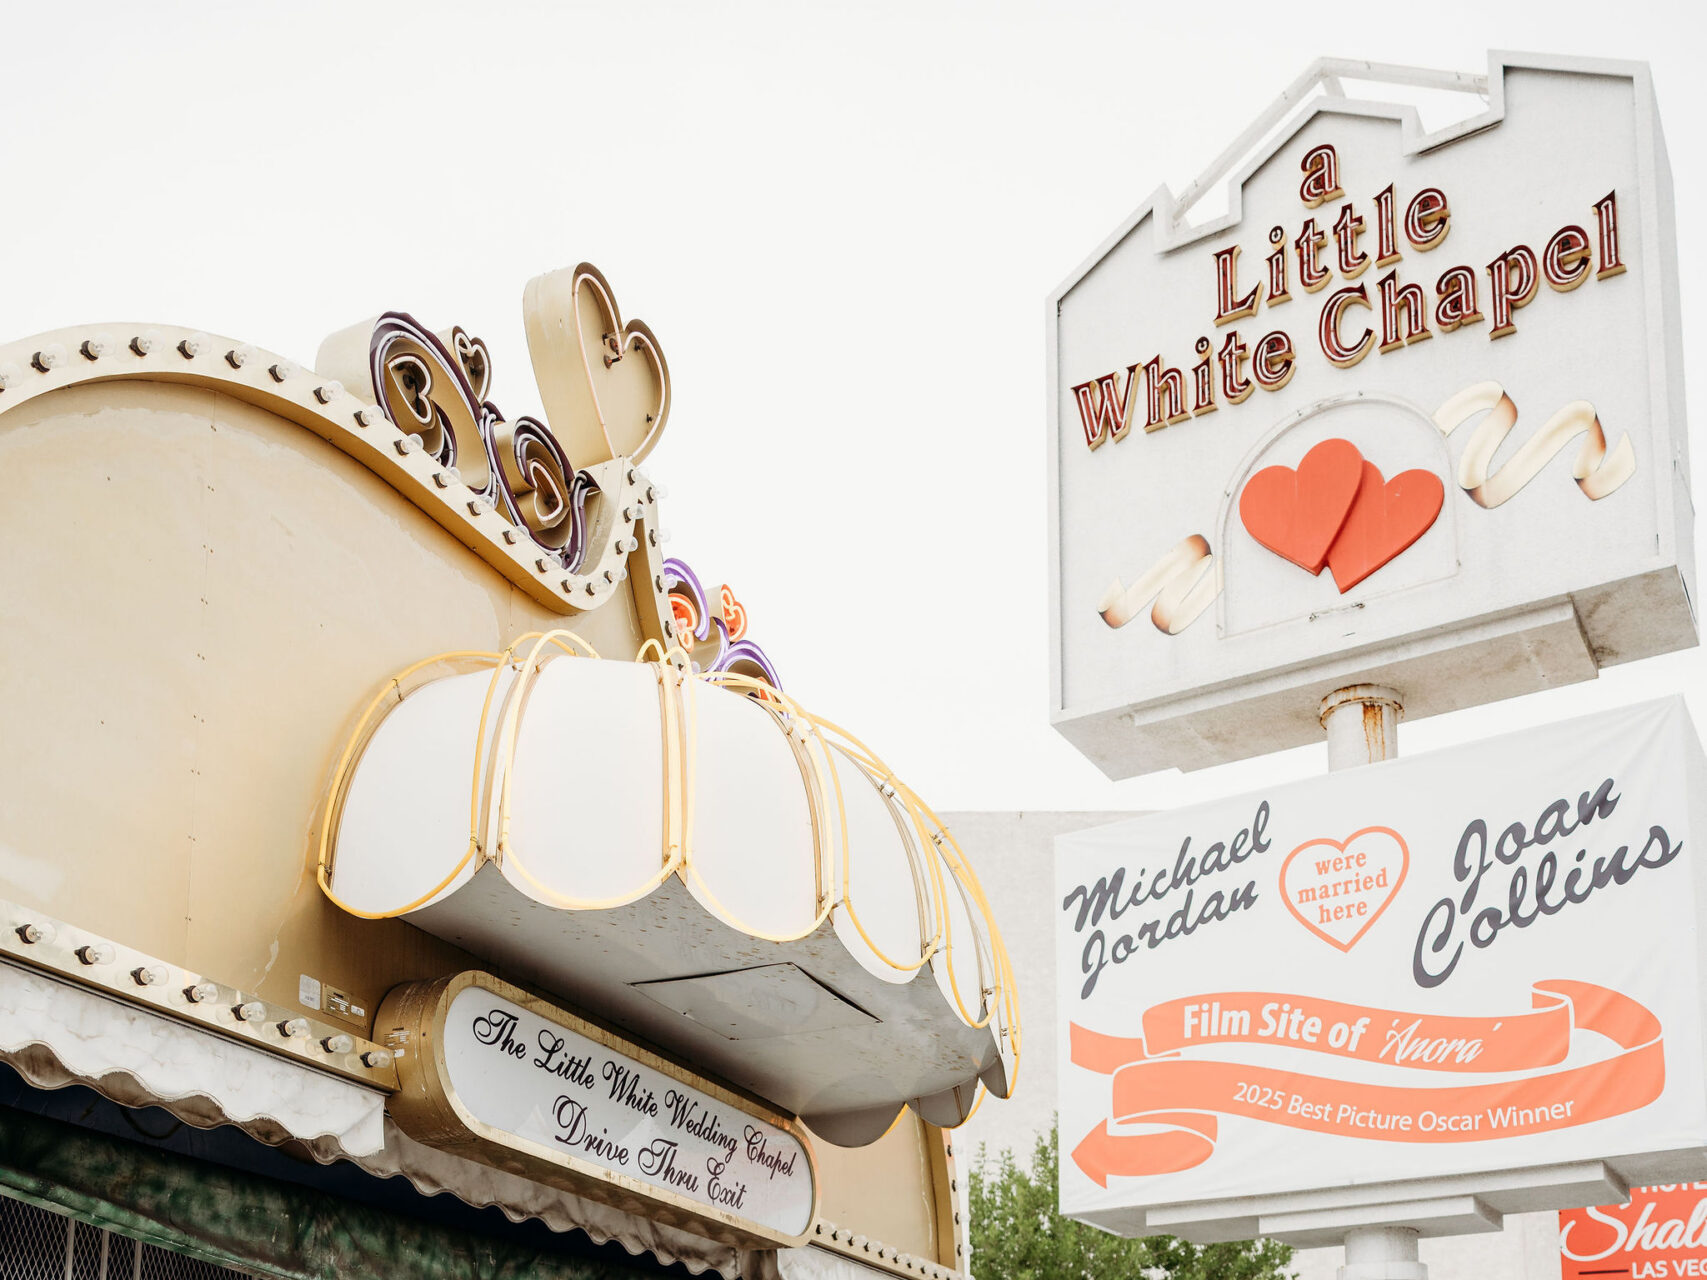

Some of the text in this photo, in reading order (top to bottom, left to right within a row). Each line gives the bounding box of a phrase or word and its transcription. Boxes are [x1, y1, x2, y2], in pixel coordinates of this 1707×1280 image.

[1299, 143, 1344, 208] a
[1213, 182, 1451, 327] Little
[1071, 190, 1626, 452] White Chapel
[1063, 800, 1272, 934] Michael
[1298, 870, 1388, 905] married
[1315, 851, 1367, 877] were
[1453, 777, 1621, 911] Joan
[1081, 880, 1259, 1000] Jordan
[1319, 899, 1367, 924] here
[1412, 825, 1683, 988] Collins
[1184, 1001, 1251, 1039] Film
[1258, 1002, 1319, 1043] Site
[1328, 1016, 1371, 1052] of
[472, 1009, 800, 1181] The Little White Wedding Chapel
[552, 1094, 747, 1210] Drive Thru Exit
[1233, 1081, 1574, 1131] 2025 Best Picture Oscar Winner
[1632, 1260, 1668, 1280] LAS
